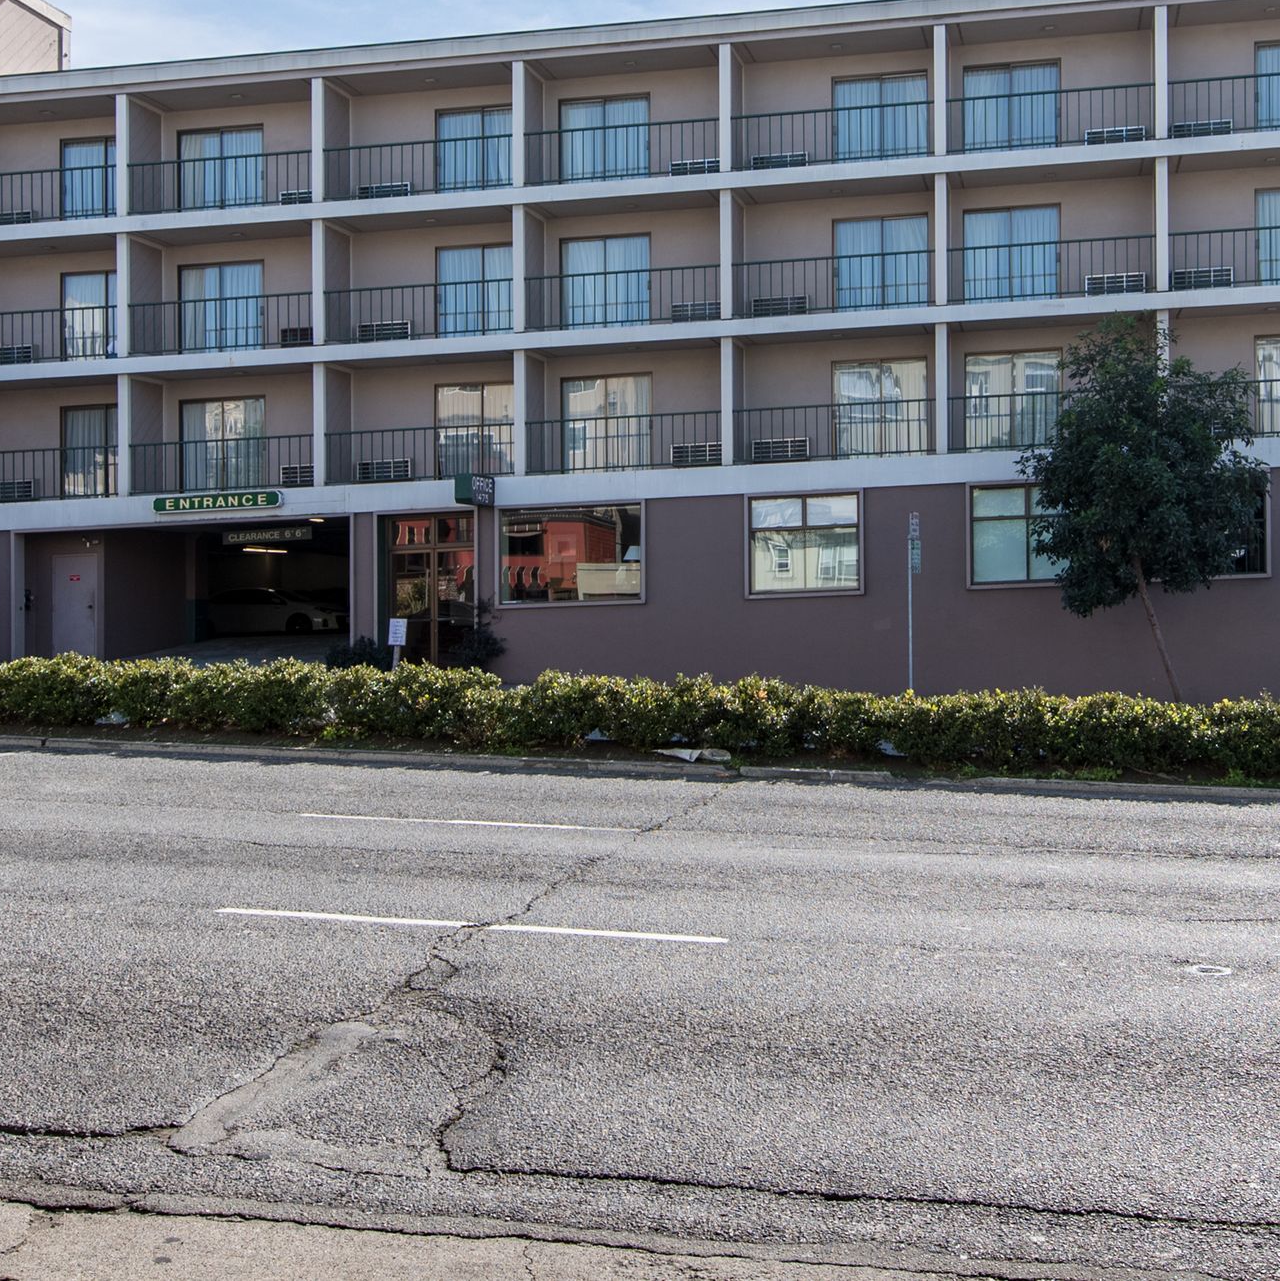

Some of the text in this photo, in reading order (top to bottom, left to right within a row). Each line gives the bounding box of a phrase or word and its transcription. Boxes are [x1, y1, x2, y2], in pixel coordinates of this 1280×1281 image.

[471, 476, 493, 493] OFFICE
[165, 493, 268, 510] ENTRANCE
[228, 530, 280, 542] CLEARANCE
